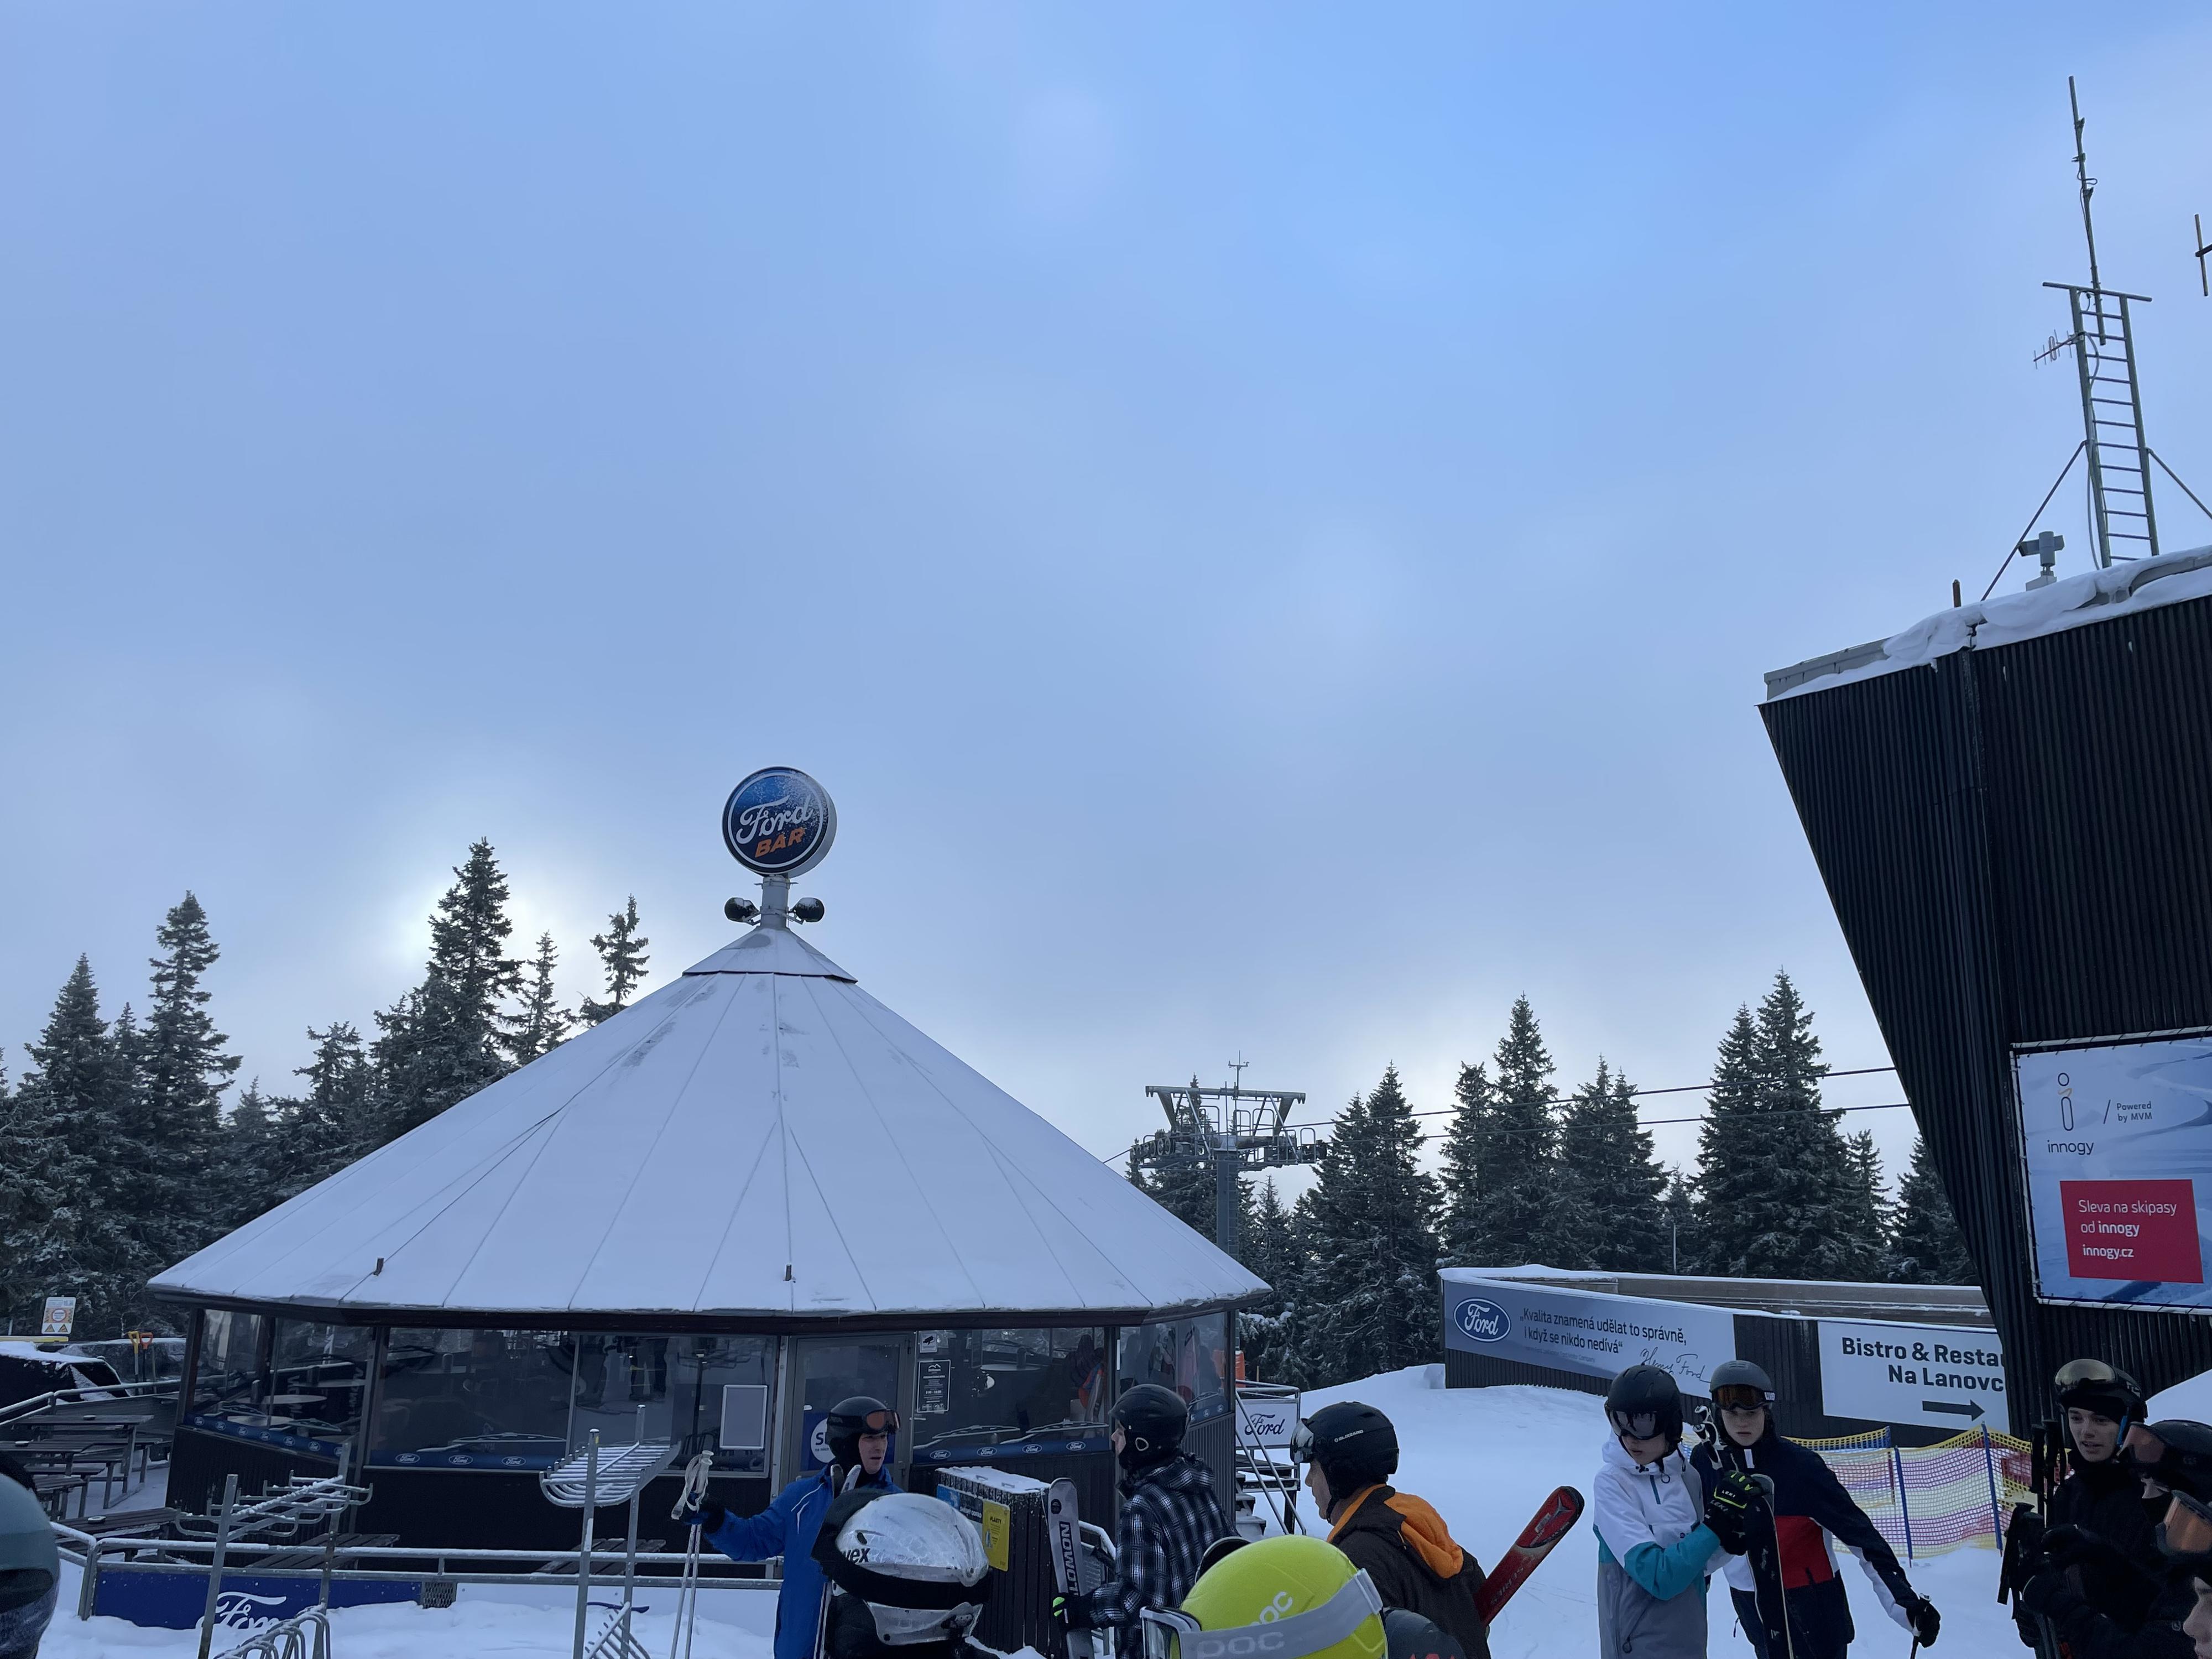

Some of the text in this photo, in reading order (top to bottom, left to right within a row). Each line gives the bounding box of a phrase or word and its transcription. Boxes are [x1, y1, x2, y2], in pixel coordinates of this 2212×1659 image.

[736, 794, 814, 844] Ford
[755, 827, 806, 858] BAR
[2116, 1101, 2152, 1111] Powered
[2131, 1113, 2152, 1121] MVM
[2047, 1140, 2094, 1155] innogy
[2078, 1200, 2177, 1216] Sleva na skipasy
[2080, 1222, 2140, 1237] od innogy
[2083, 1244, 2134, 1260] innogy.cz
[1464, 1303, 1499, 1335] Ford
[1528, 1327, 1548, 1343] když
[1550, 1333, 1559, 1344] se
[1561, 1332, 1585, 1348] nikdo
[1554, 1316, 1595, 1330] znamená
[1597, 1318, 1627, 1335] udělat
[1629, 1322, 1640, 1337] to
[1642, 1325, 1687, 1345] správně,
[1842, 1337, 1907, 1359] Bistro
[1912, 1342, 1929, 1361] &
[1888, 1365, 1917, 1384] Na
[1244, 1413, 1285, 1436] Ford
[1250, 1591, 1293, 1625] OC
